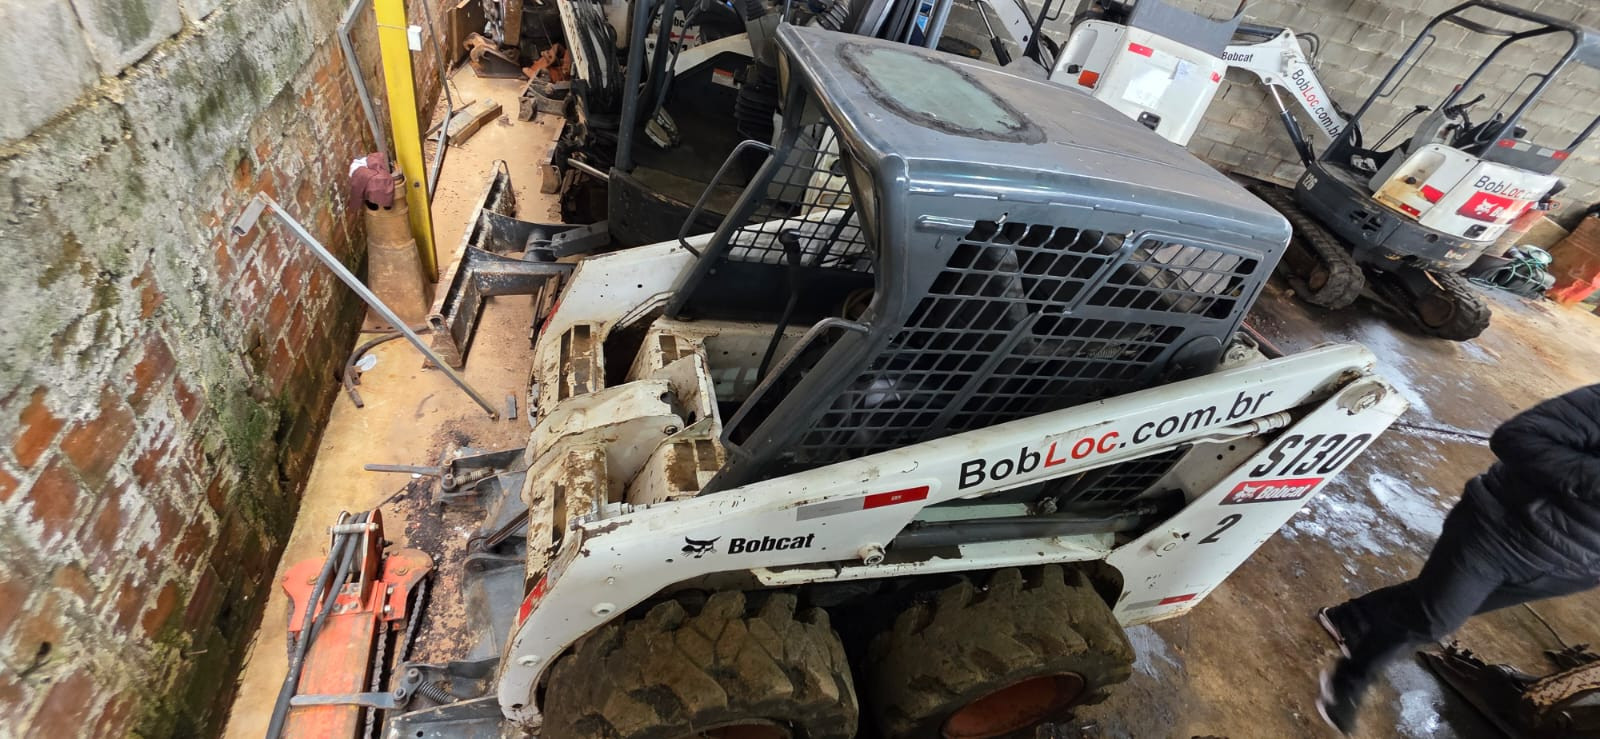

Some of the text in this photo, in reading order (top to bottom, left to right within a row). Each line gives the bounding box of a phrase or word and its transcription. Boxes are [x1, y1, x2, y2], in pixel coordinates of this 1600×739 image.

[1221, 51, 1254, 62] Bobcat
[957, 390, 1274, 490] BobLoc.com.br
[1249, 433, 1372, 477] S130
[1256, 485, 1311, 500] Bobcat
[1198, 513, 1242, 544] 2
[727, 533, 815, 555] Bobcat
